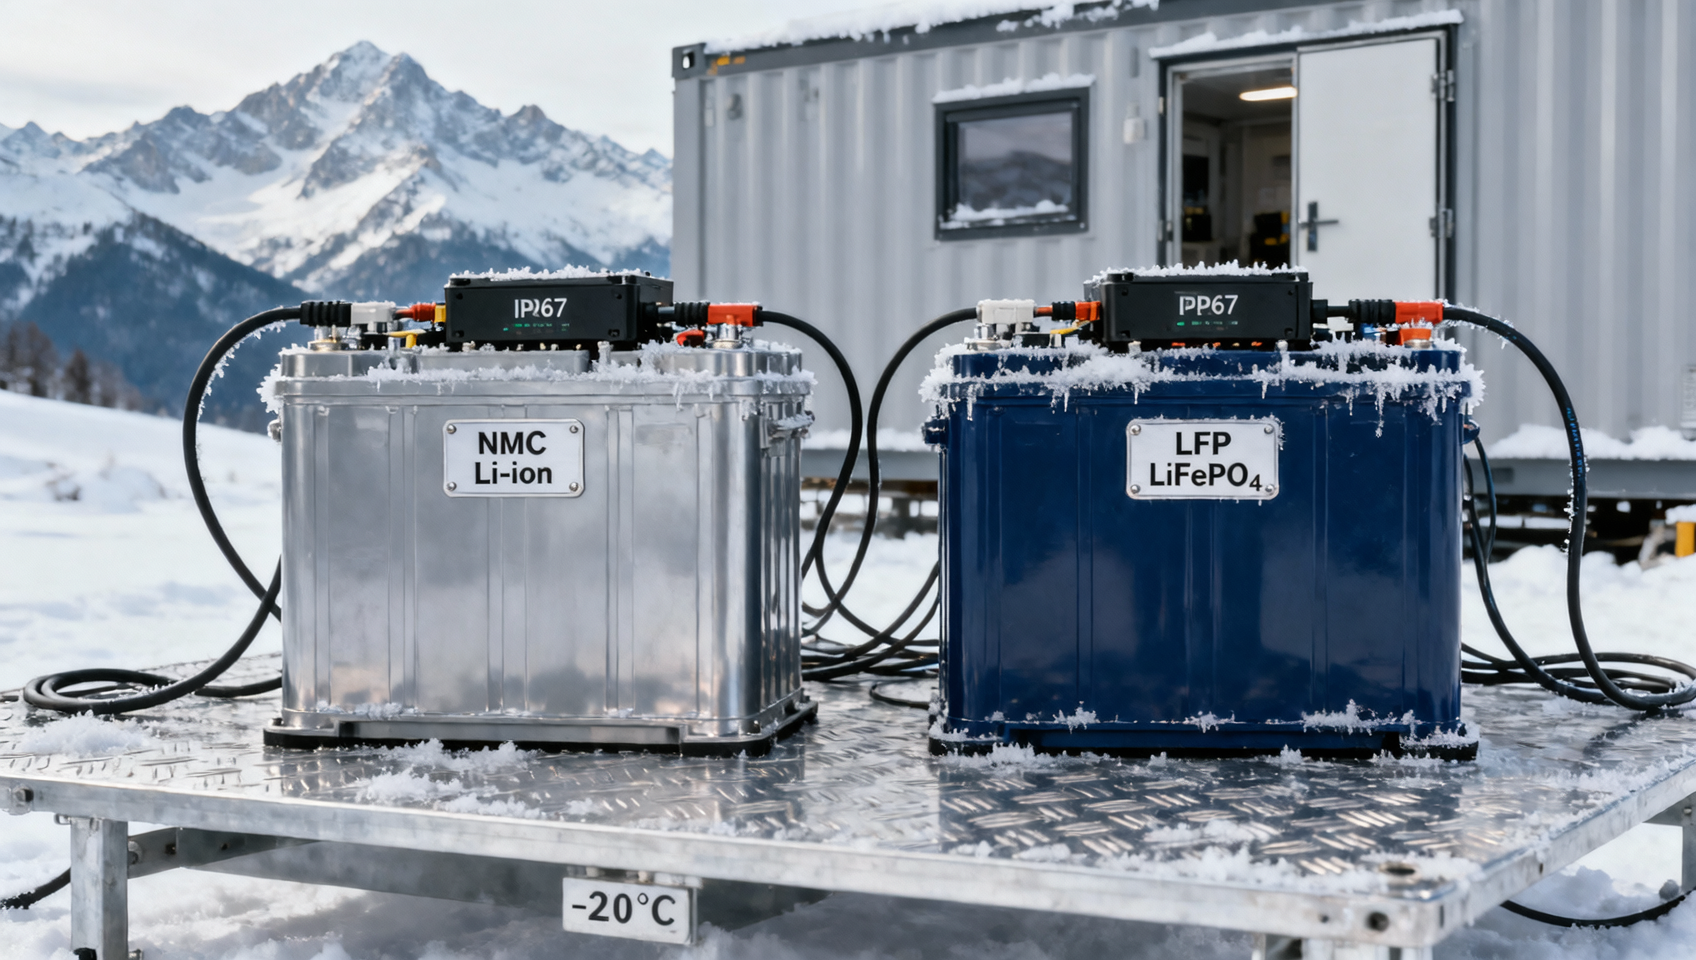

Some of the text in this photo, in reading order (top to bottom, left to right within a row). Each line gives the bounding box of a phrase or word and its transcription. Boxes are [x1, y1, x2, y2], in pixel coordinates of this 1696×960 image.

[478, 430, 547, 455] NMC
[1175, 431, 1232, 456] LFP
[474, 461, 553, 485] Li-ion
